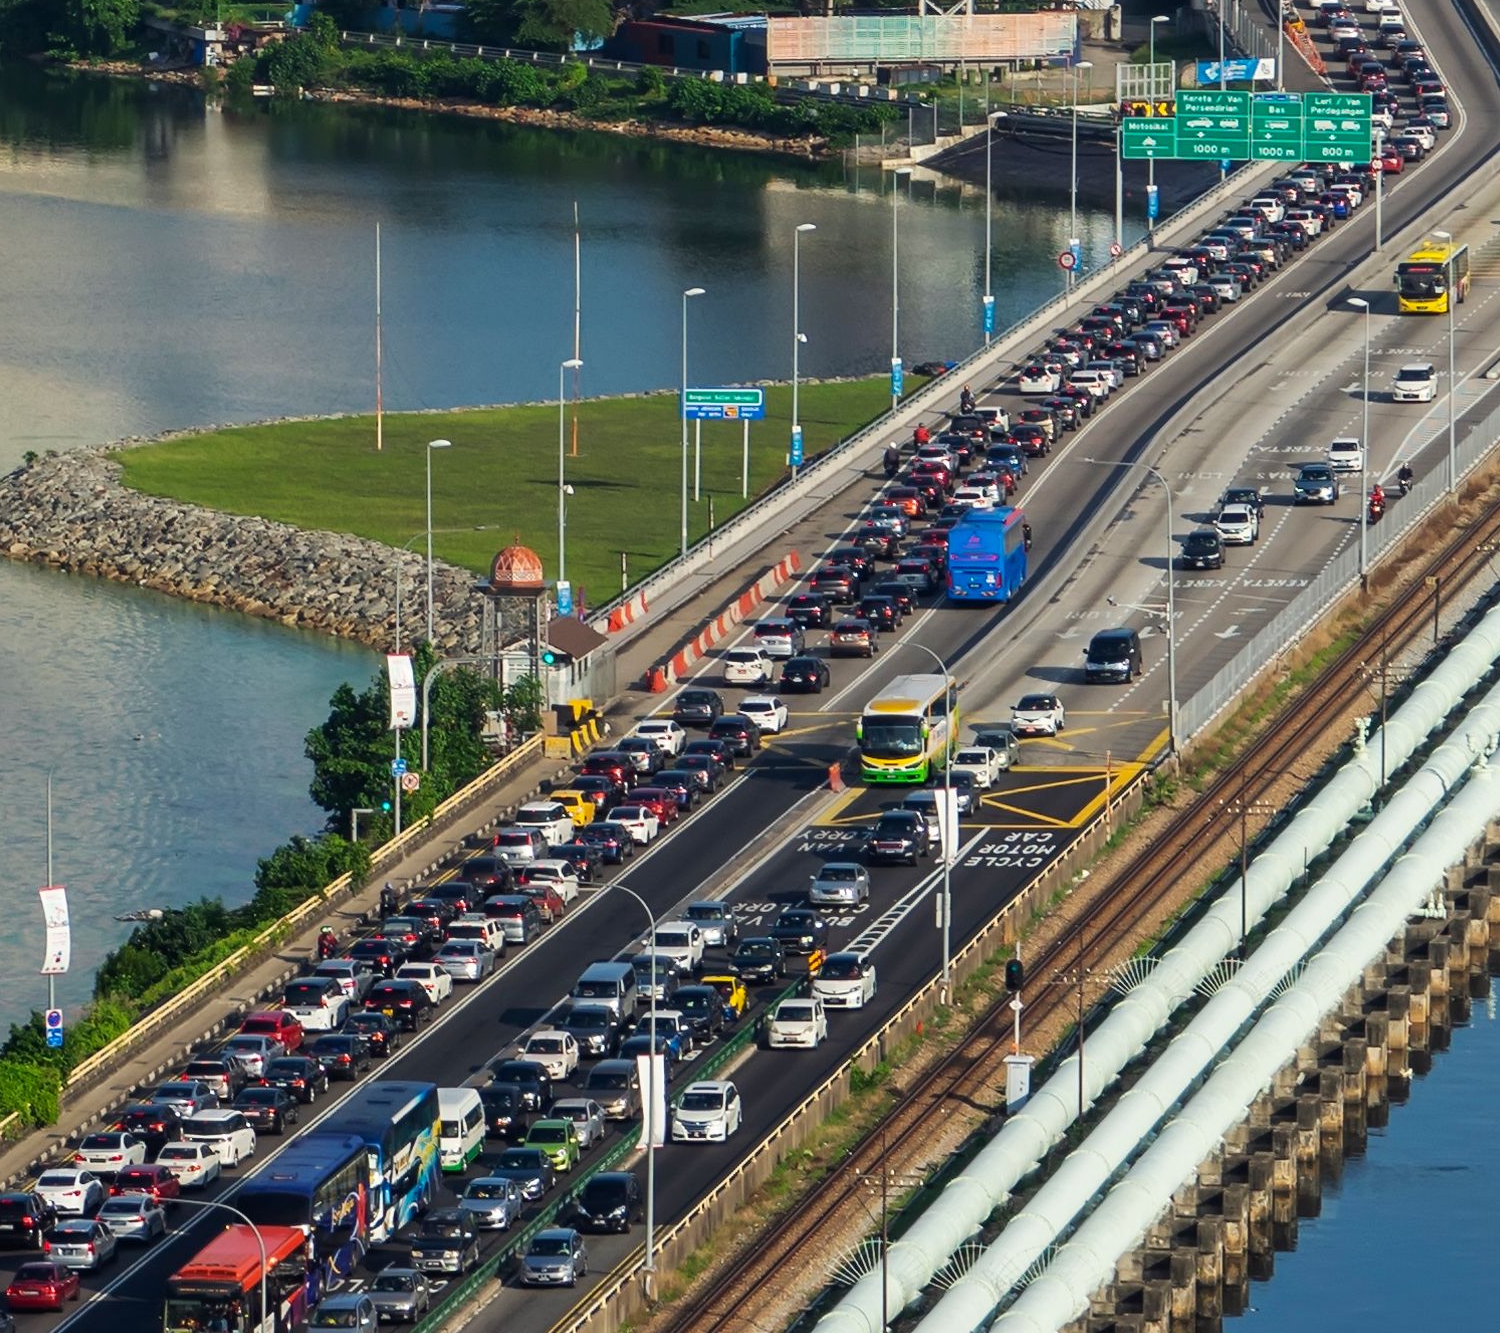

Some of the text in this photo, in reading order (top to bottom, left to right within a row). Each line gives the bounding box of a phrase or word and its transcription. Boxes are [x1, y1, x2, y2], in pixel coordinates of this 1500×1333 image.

[1183, 95, 1212, 103] Kereta
[1314, 97, 1333, 106] Lori
[1346, 98, 1360, 106] Van
[1185, 104, 1238, 112] Persendirian
[1268, 106, 1285, 114] Bas
[1311, 107, 1365, 116] Perdagangan
[1194, 145, 1218, 153] 1000
[1259, 148, 1282, 156] 1000
[1322, 148, 1341, 156] 800
[1161, 579, 1228, 587] KERETA
[1243, 579, 1309, 587] KERETA
[797, 830, 873, 841] LORRY
[1004, 832, 1054, 843] CAR
[798, 843, 845, 852] VAN
[979, 844, 1056, 855] MOTOR
[964, 857, 1043, 868] CYCLE
[731, 901, 793, 913] LORR
